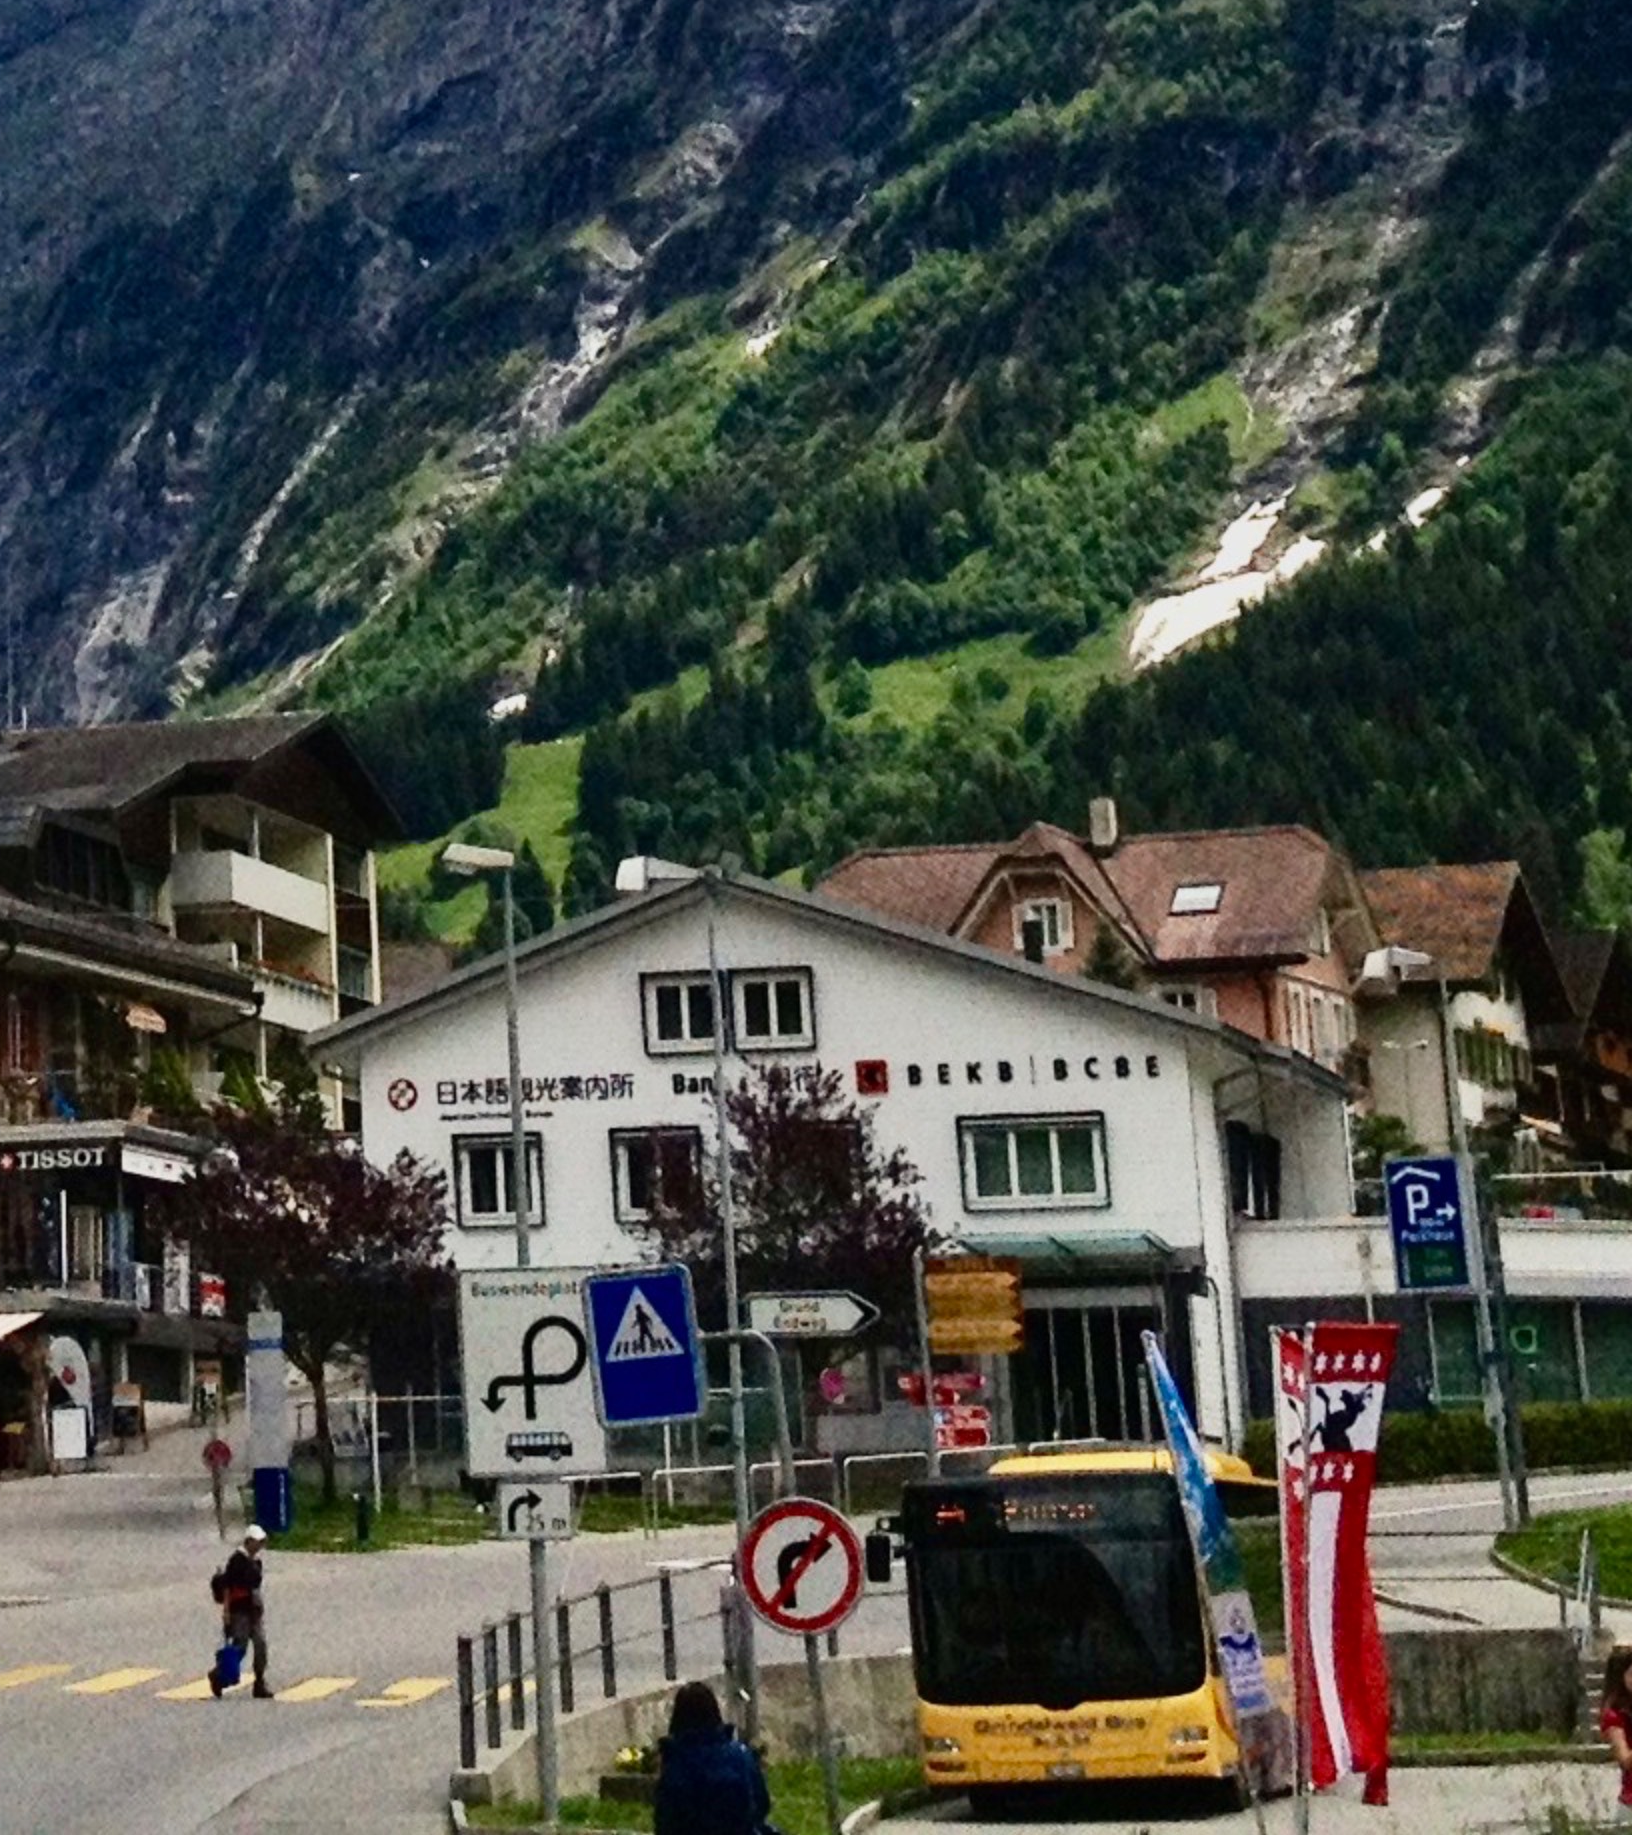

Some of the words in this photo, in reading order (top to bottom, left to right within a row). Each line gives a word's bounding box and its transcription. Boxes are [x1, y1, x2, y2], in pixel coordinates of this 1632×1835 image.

[907, 1060, 1014, 1087] BEKB
[1053, 1054, 1162, 1081] BCBE
[17, 1146, 106, 1171] TISSOT
[1405, 1183, 1431, 1226] P
[471, 1280, 581, 1300] Buswendeplat
